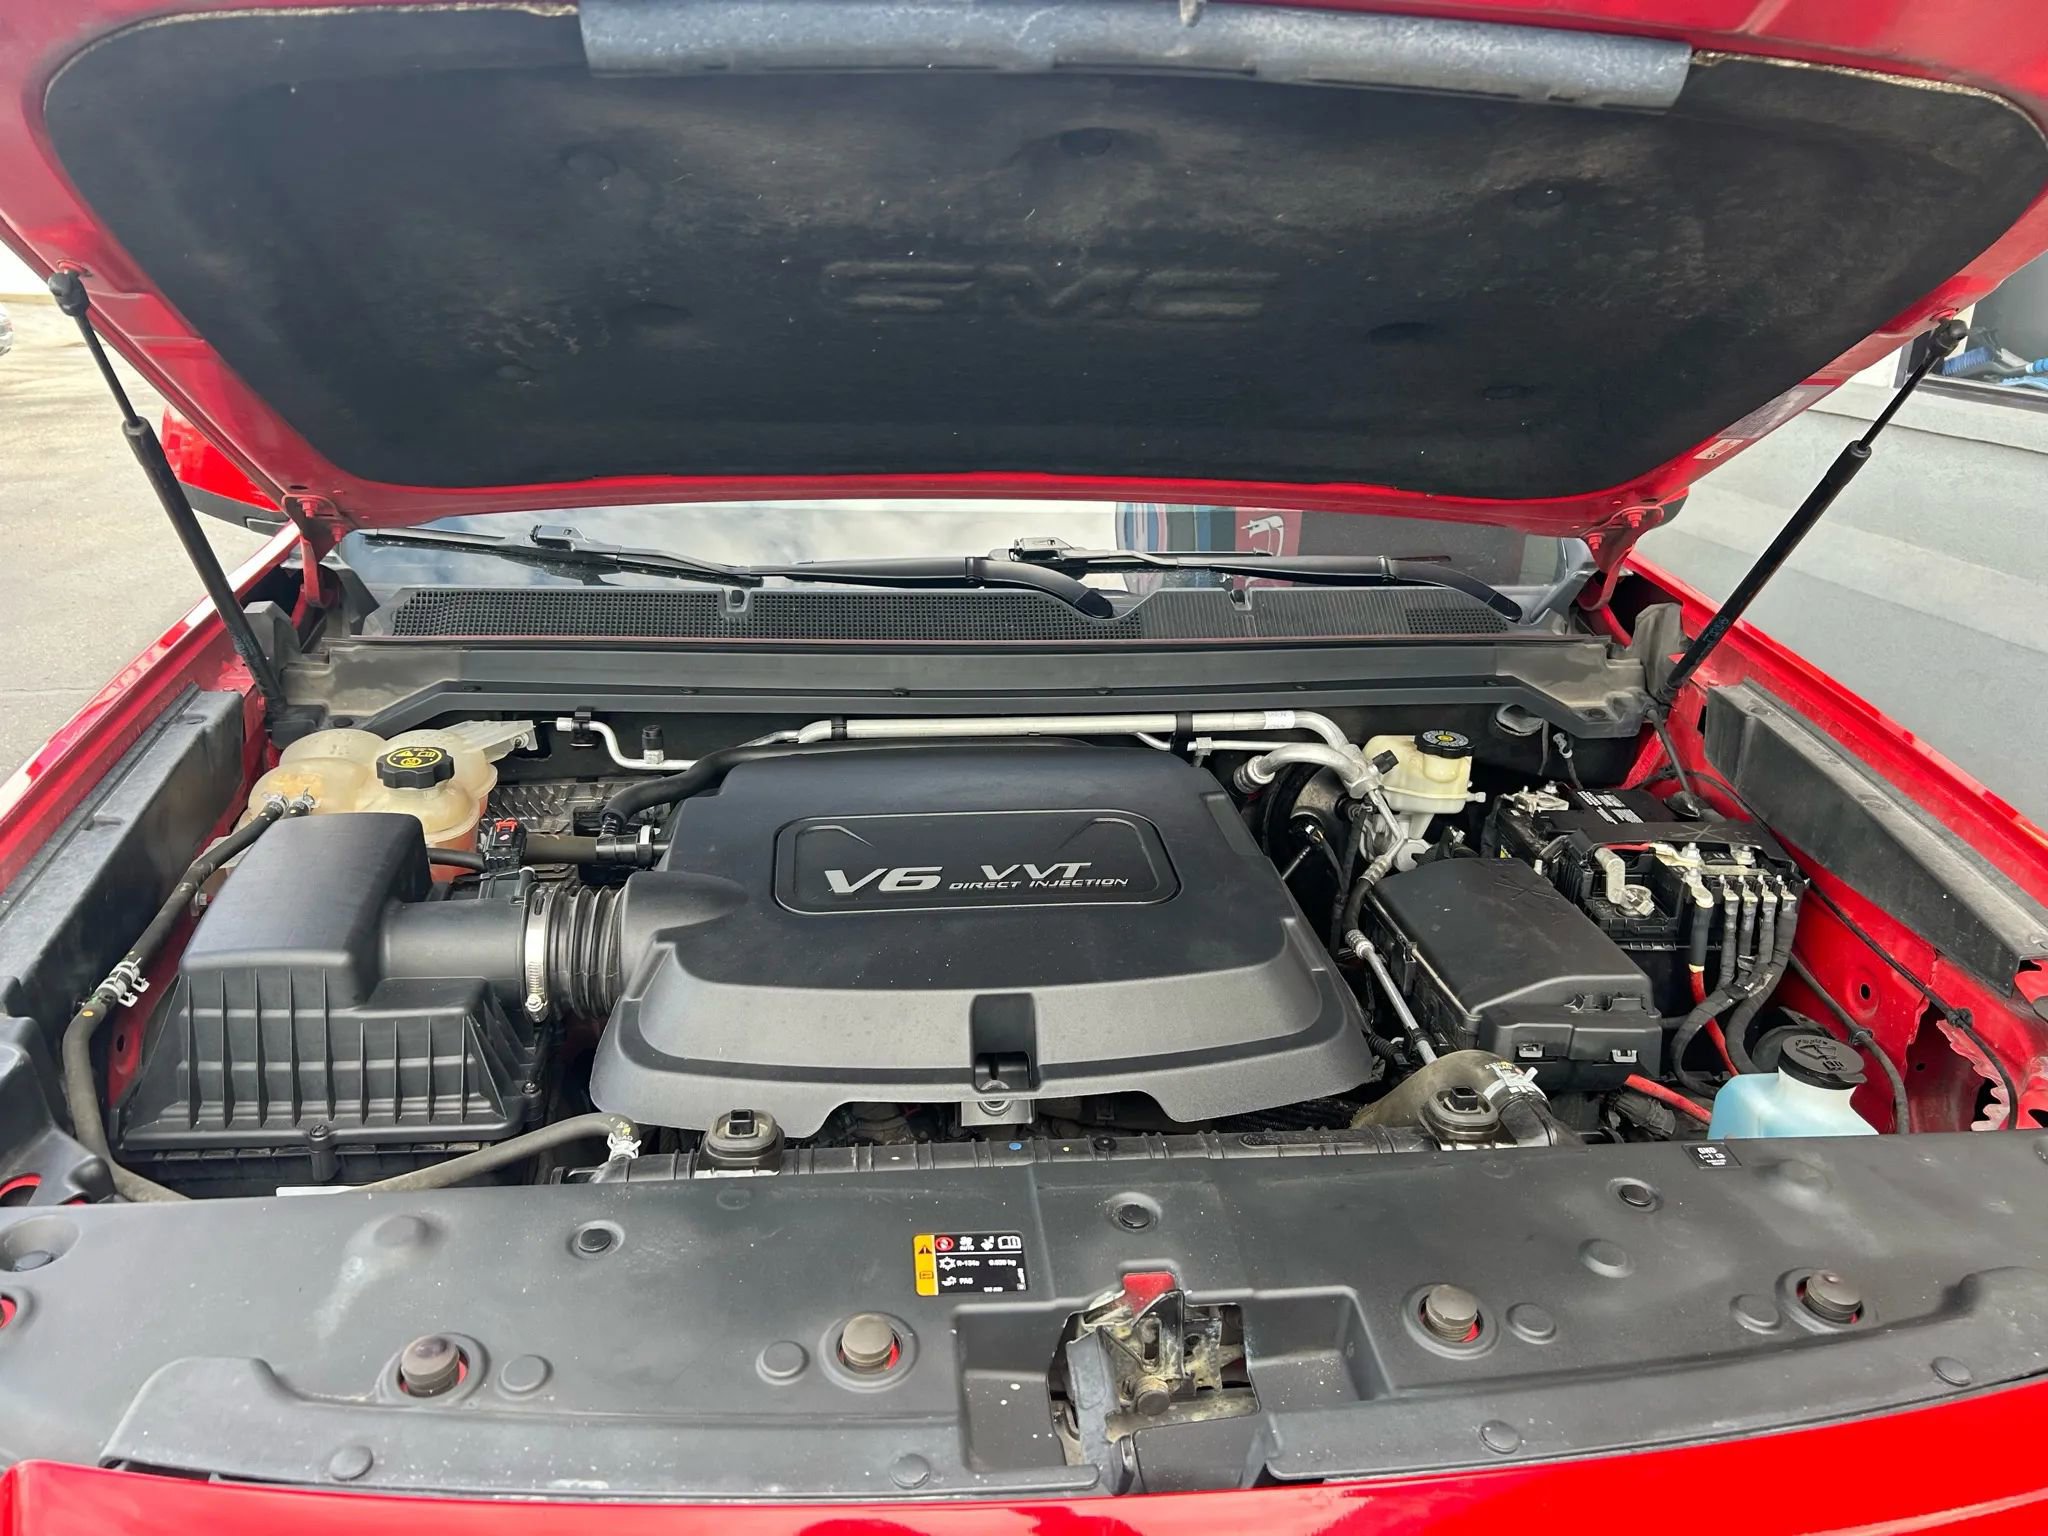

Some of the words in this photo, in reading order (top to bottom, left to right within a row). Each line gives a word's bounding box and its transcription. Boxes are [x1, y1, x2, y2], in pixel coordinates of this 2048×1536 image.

[824, 866, 943, 894] V6
[980, 862, 1092, 880] VVT
[949, 880, 1021, 890] DIRECT
[1029, 877, 1128, 888] INJECTION
